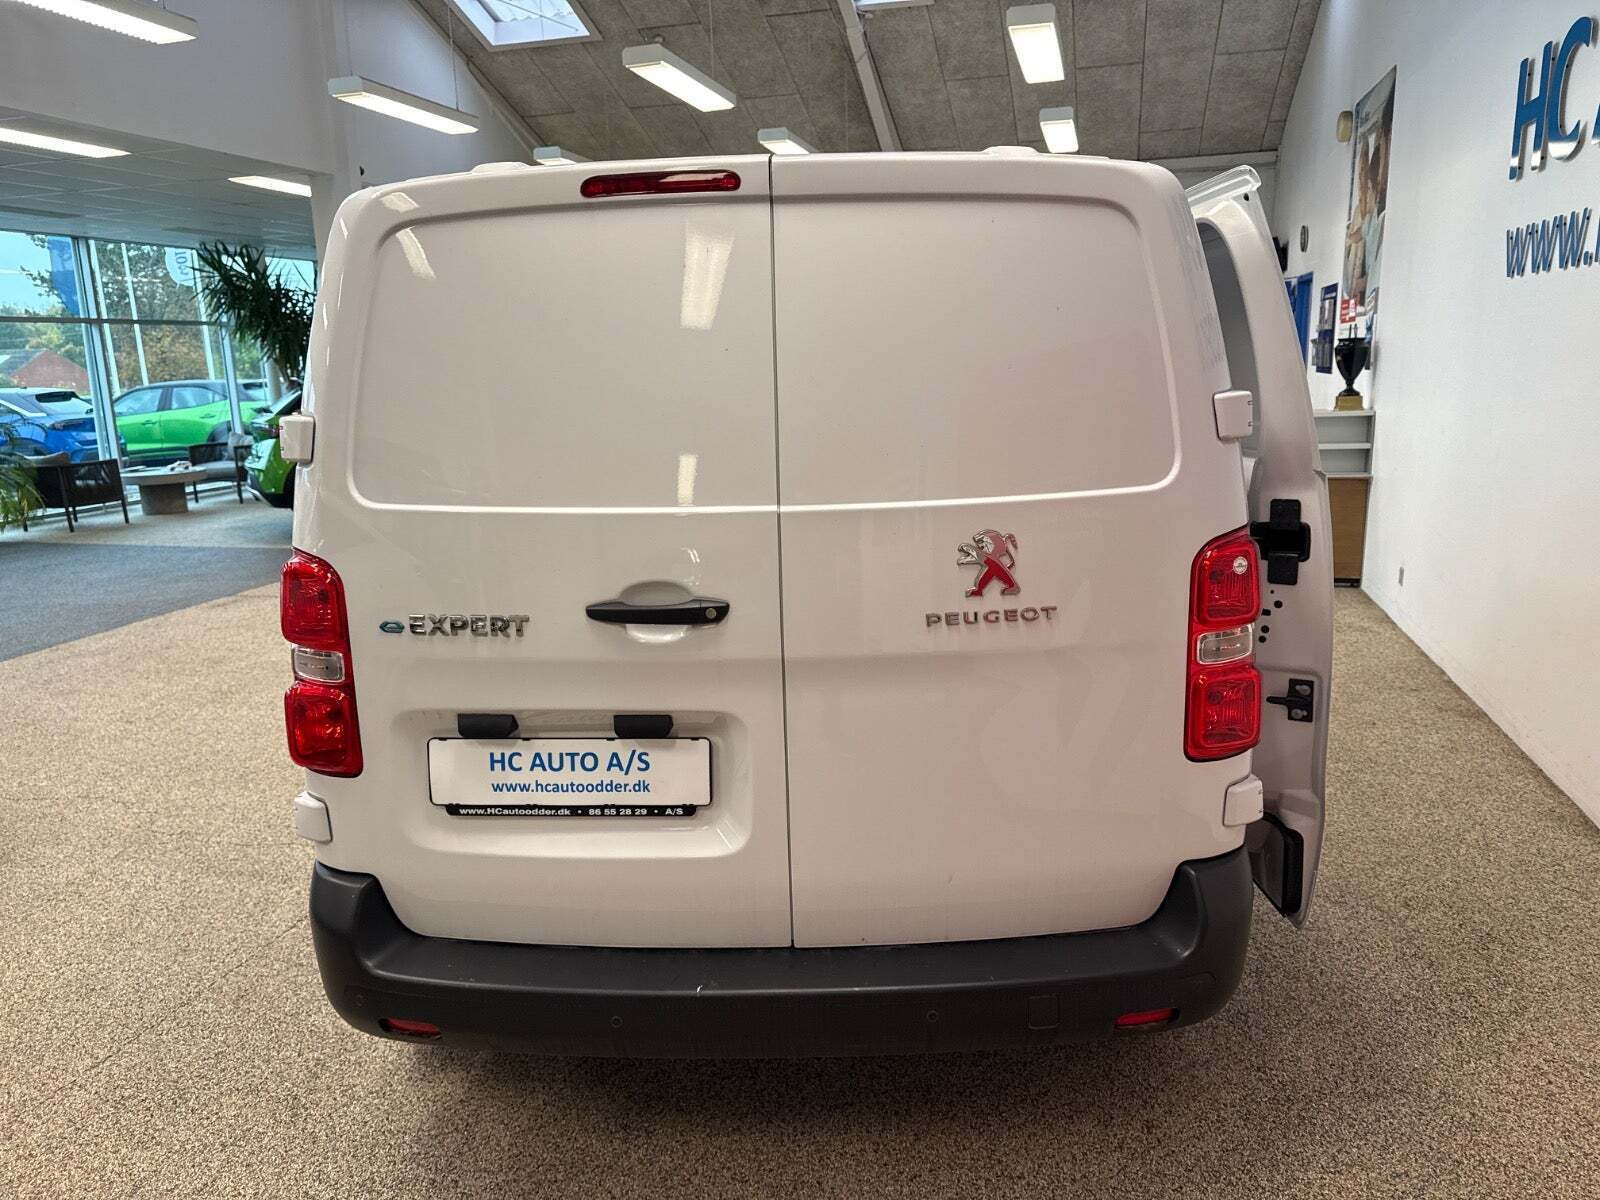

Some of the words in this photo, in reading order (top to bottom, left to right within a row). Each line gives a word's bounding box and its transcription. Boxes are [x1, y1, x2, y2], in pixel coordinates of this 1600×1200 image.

[1508, 16, 1594, 181] HC
[408, 614, 530, 638] EXPERT
[925, 605, 1058, 628] PEUGEOT
[489, 752, 523, 772] HC
[529, 752, 599, 772] AUTO
[606, 750, 651, 775] A/S
[491, 780, 651, 793] www.hcautoodder.dk
[459, 807, 571, 816] www.HCautoodder.dk
[603, 808, 617, 816] 55
[619, 808, 632, 816] 28
[634, 808, 648, 816] 29
[665, 807, 684, 816] A/S
